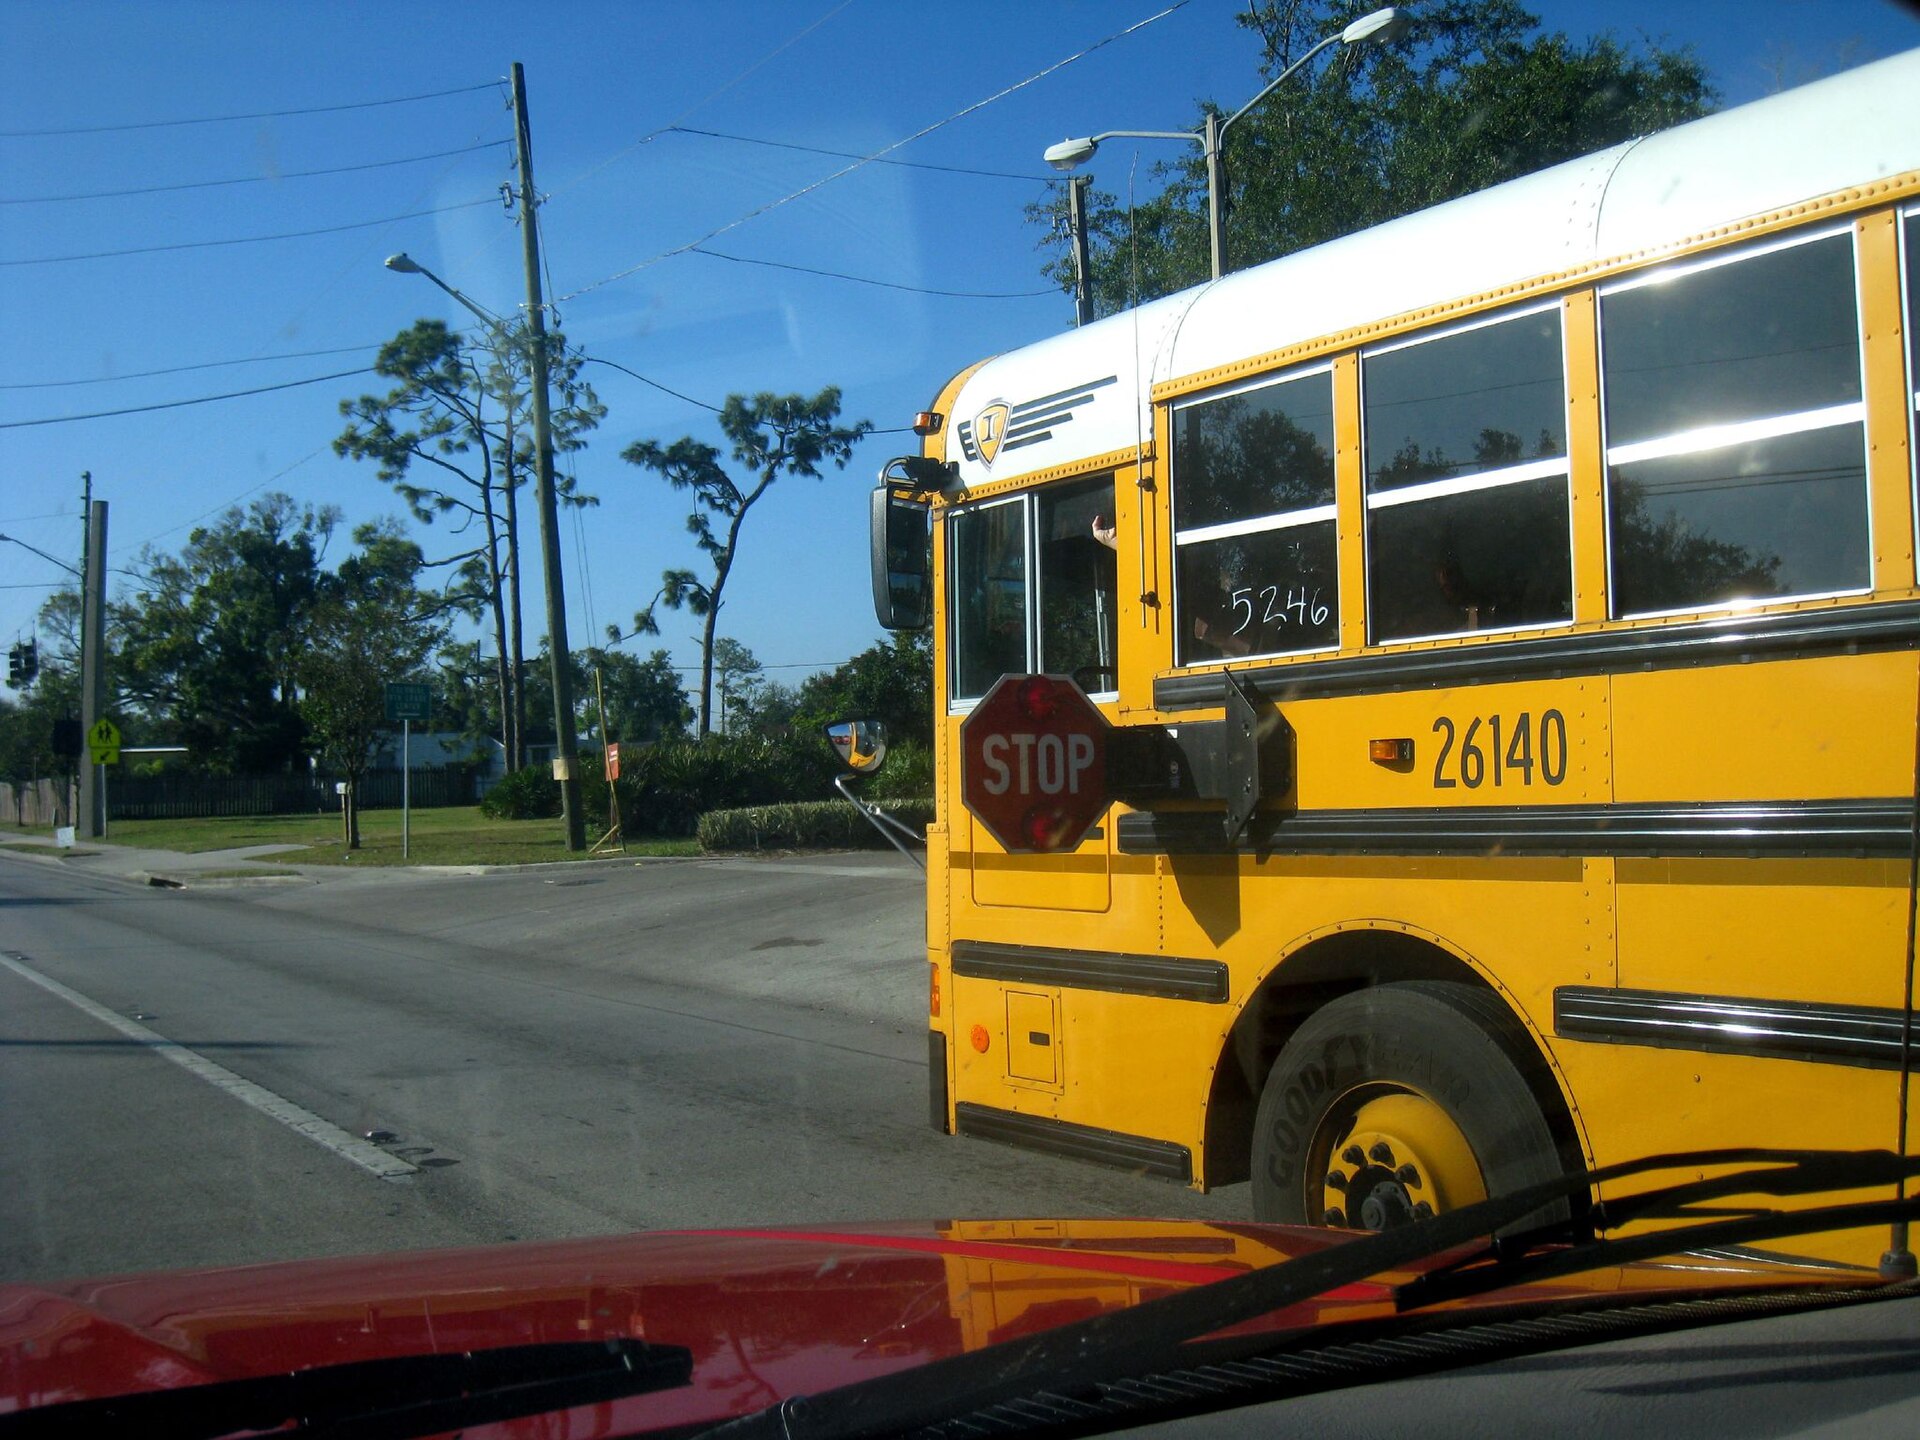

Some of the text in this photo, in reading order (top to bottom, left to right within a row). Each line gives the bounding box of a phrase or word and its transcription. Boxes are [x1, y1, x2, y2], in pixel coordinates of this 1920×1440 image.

[1230, 584, 1330, 635] 5246
[982, 733, 1095, 795] STOP
[1432, 708, 1568, 789] 26140
